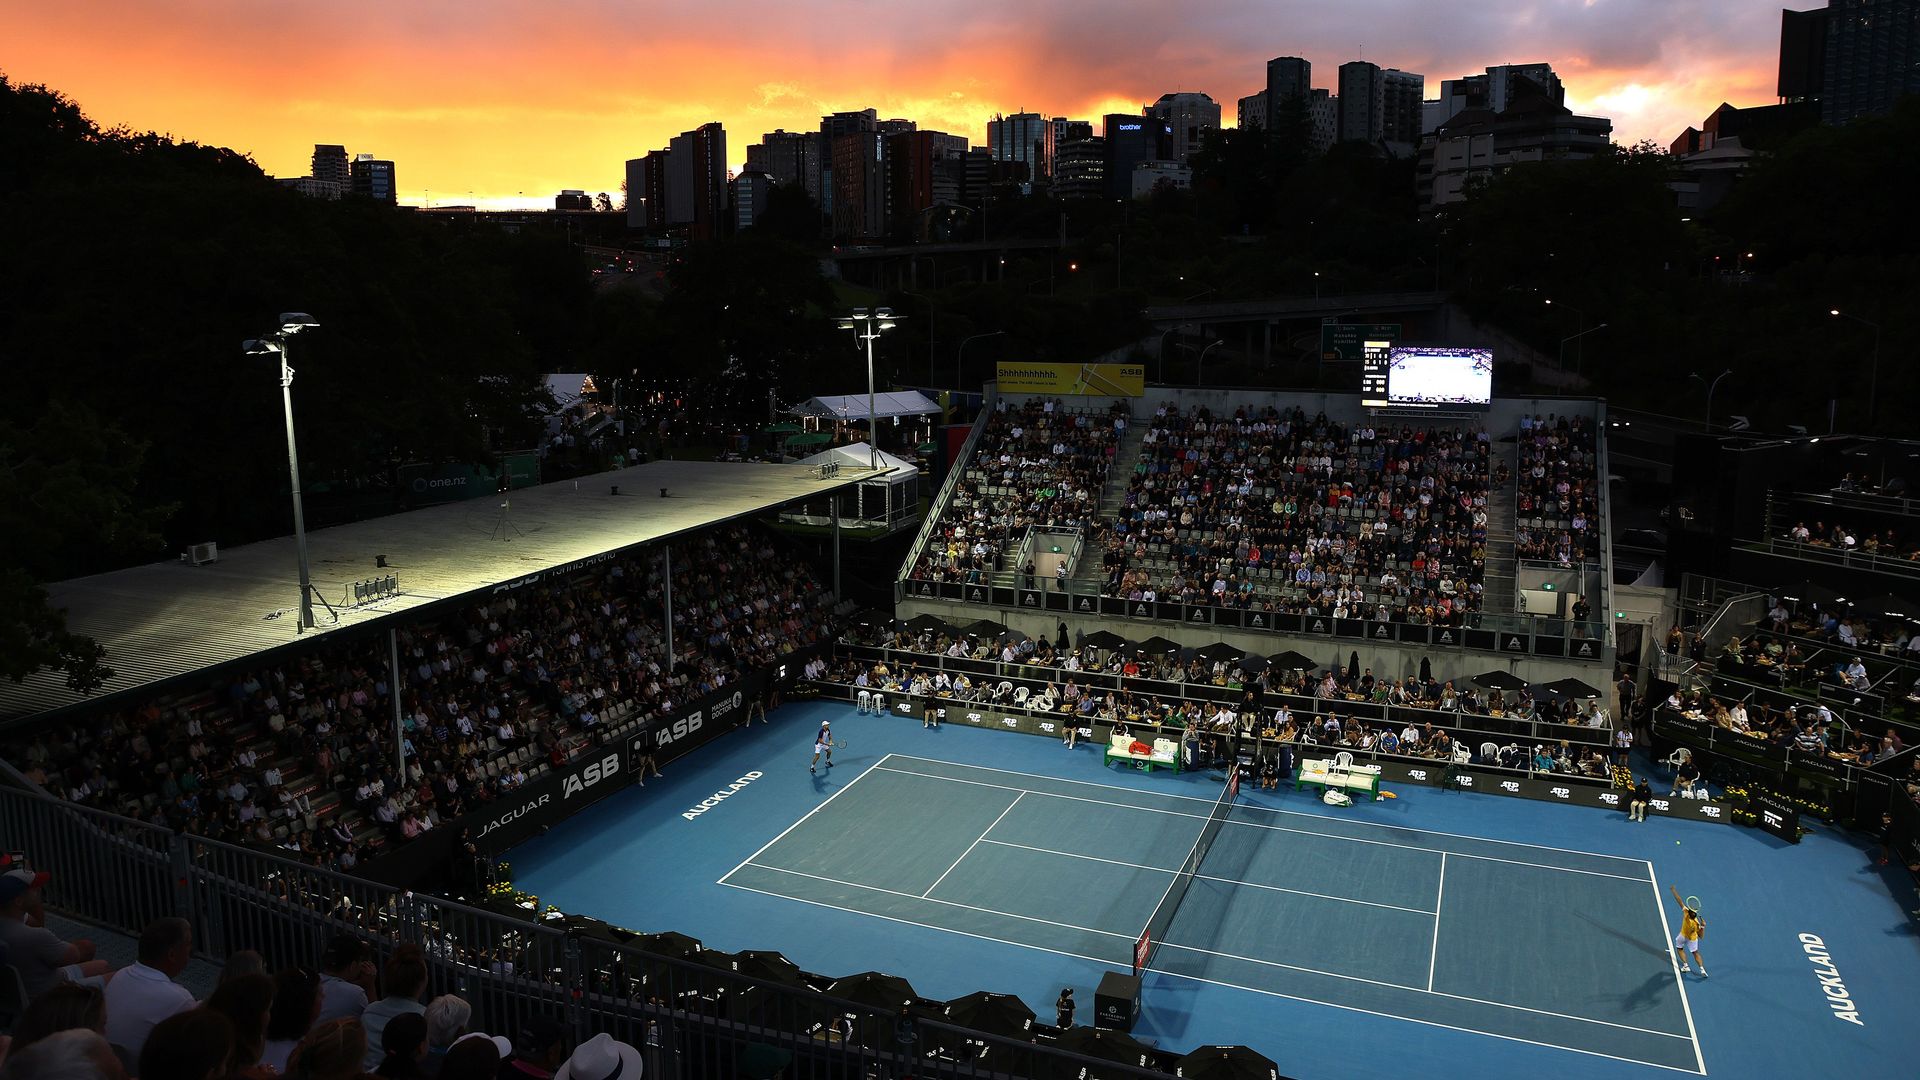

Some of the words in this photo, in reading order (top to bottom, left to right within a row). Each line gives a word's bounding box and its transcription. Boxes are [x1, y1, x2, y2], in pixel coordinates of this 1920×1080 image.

[430, 477, 466, 487] one.nz
[711, 697, 731, 711] MANUKA
[711, 704, 732, 719] DOCTOR
[656, 711, 702, 745] ASB
[1668, 719, 1697, 730] JAGUAR
[1735, 738, 1766, 751] JAGUAR
[1800, 759, 1834, 771] JAGUAR
[562, 753, 619, 799] ASB
[682, 771, 763, 820] AUCKLAND
[1700, 806, 1720, 814] ATP
[1759, 797, 1792, 814] JAGUAR
[477, 794, 550, 838] JAGUAR
[1764, 814, 1776, 826] 171
[1798, 932, 1864, 1026] AUCKLAND
